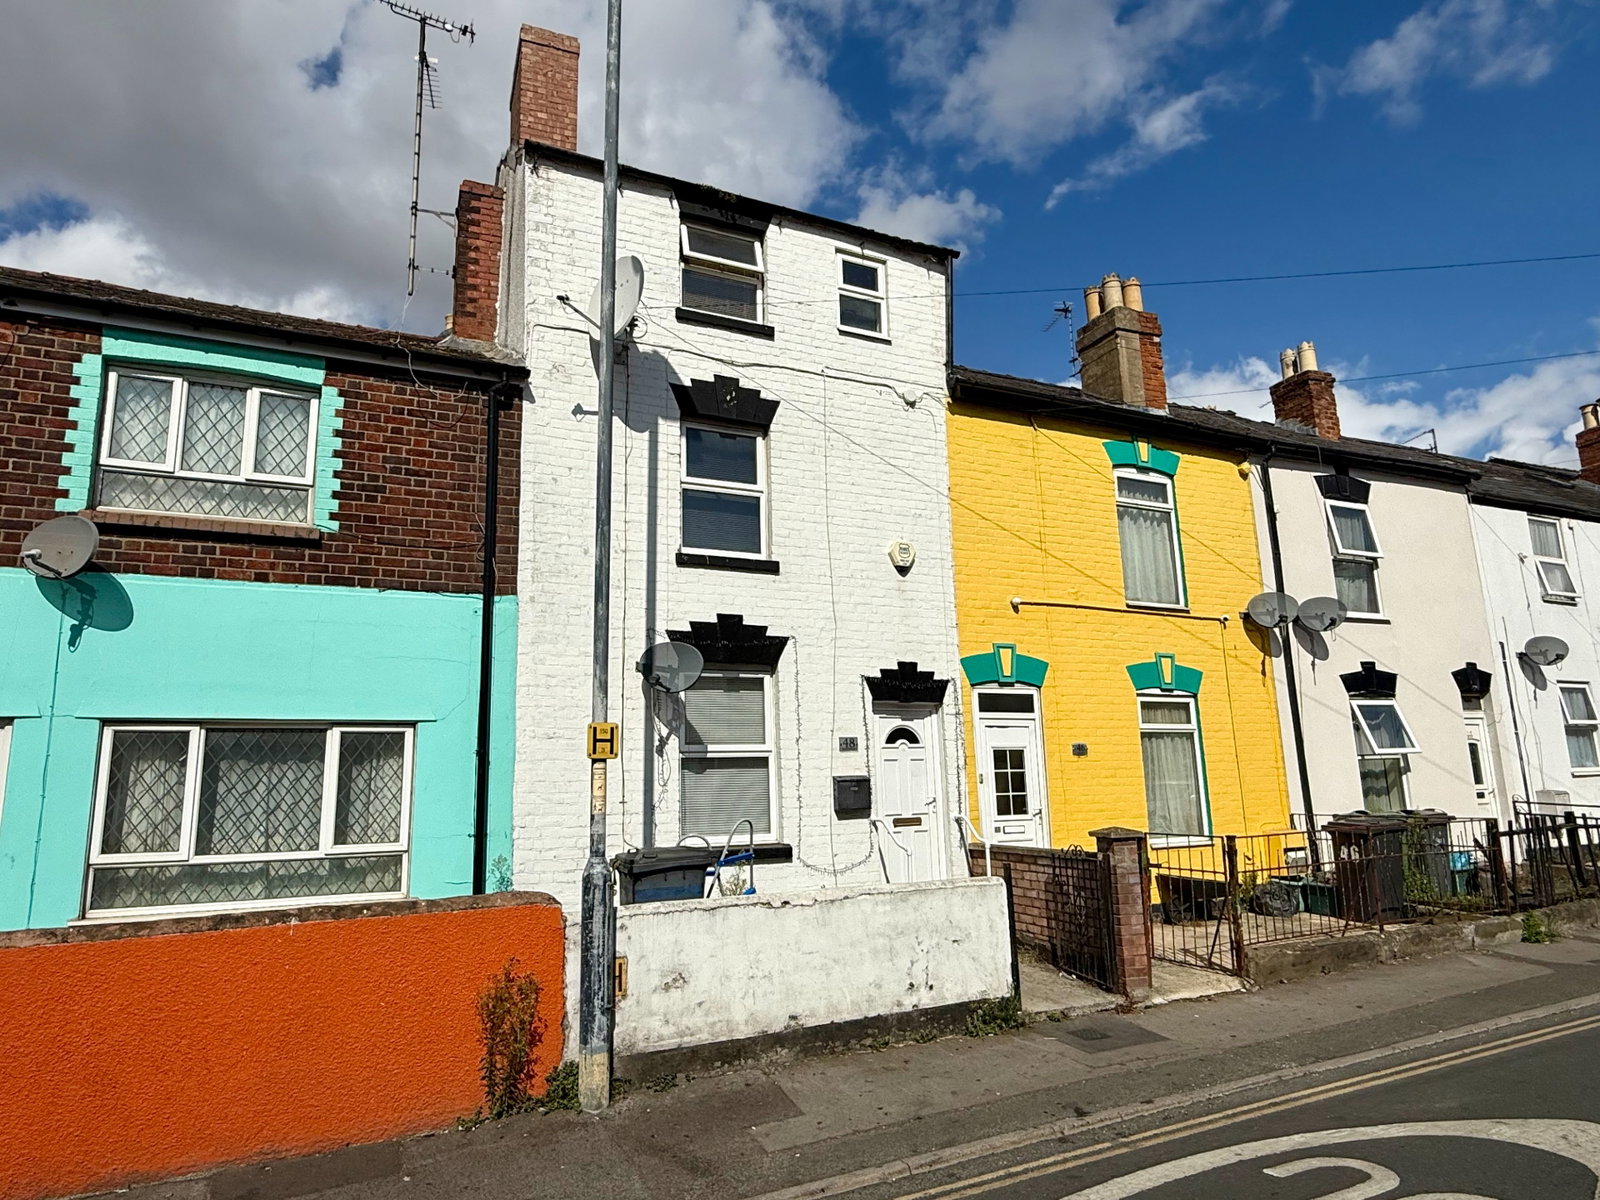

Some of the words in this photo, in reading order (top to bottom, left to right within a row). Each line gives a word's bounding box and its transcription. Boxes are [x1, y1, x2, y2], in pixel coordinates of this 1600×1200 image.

[592, 726, 614, 755] H
[842, 737, 856, 748] 48
[1340, 844, 1359, 862] 46
